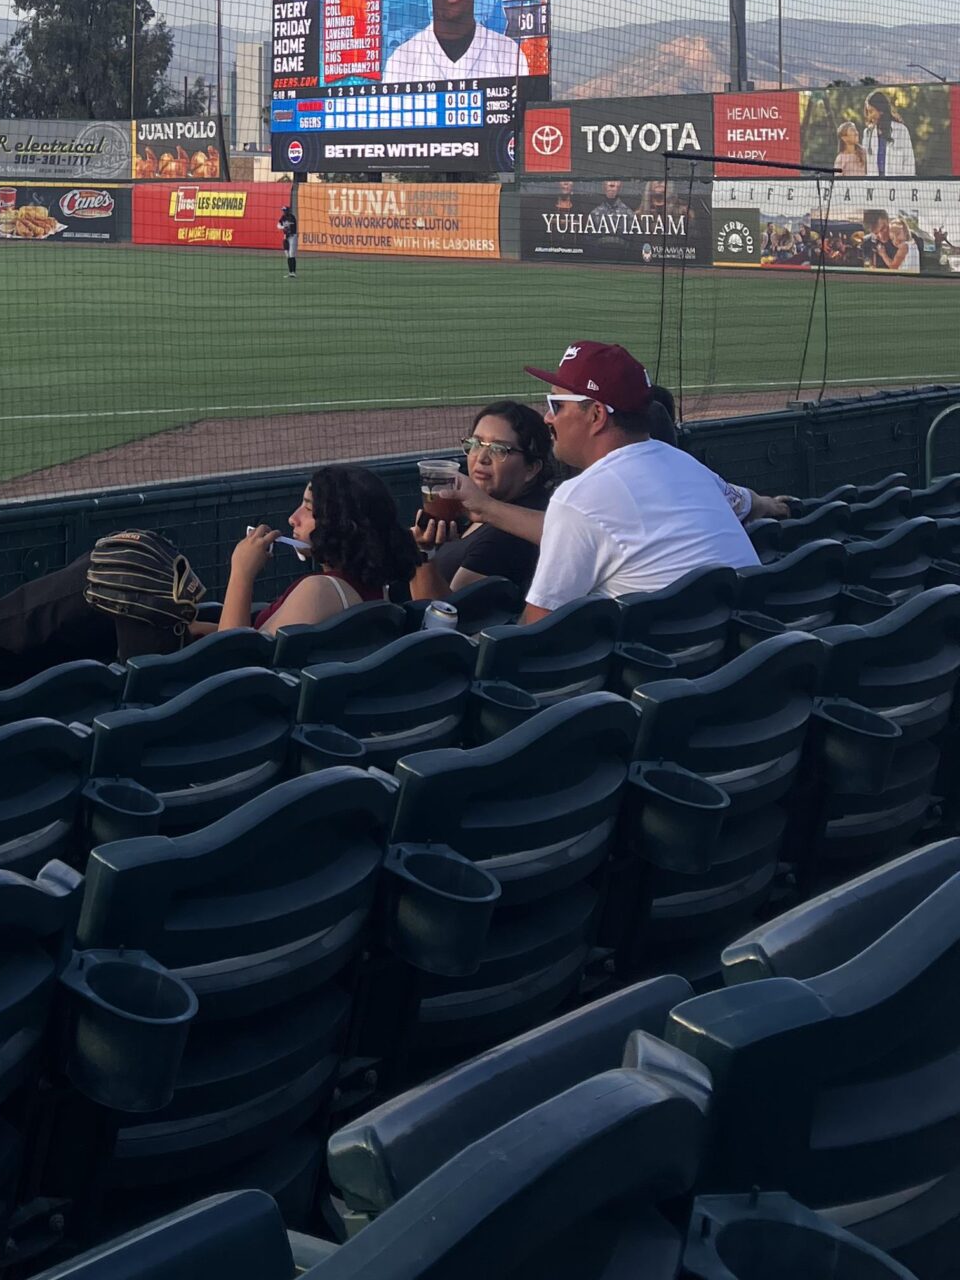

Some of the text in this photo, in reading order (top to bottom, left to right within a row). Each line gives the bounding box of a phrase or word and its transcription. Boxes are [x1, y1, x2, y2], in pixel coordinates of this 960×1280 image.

[274, 1, 308, 19] EVERY
[325, 5, 341, 16] COLL
[274, 19, 312, 37] FRIDAY
[325, 24, 380, 40] LAVERDE 232
[273, 38, 305, 55] HOME
[366, 37, 380, 48] 211
[273, 56, 304, 73] GAME
[325, 50, 379, 63] RIOS 281
[328, 80, 478, 97] 1 2 3 4 5 6 7 8 9 10 R H E
[486, 87, 510, 98] BALLS:
[448, 95, 453, 106] 0
[461, 94, 465, 105] 0
[473, 94, 478, 105] 0
[300, 111, 478, 129] 66ERS 0 0 0
[486, 113, 510, 124] OUTS:
[727, 106, 782, 121] HEALING.
[138, 121, 216, 141] JUAN POLLO
[581, 122, 701, 153] TOYOTA
[727, 128, 789, 142] HEALTHY.
[14, 135, 105, 154] electrical
[325, 142, 479, 158] BETTER WITH PEPSI
[14, 154, 91, 166] 909-381-1717
[198, 196, 244, 210] LES SCHWAB
[328, 189, 407, 215] LiUNA!
[730, 187, 960, 203] LIFE PANORA
[329, 216, 459, 231] YOUR WORKFORCE SOLUTION
[541, 213, 687, 236] YUHAAVIATAM
[302, 233, 495, 251] BUILD YOUR FUTURE WITH THE LABORERS
[717, 221, 754, 254] SILVERWOOD
